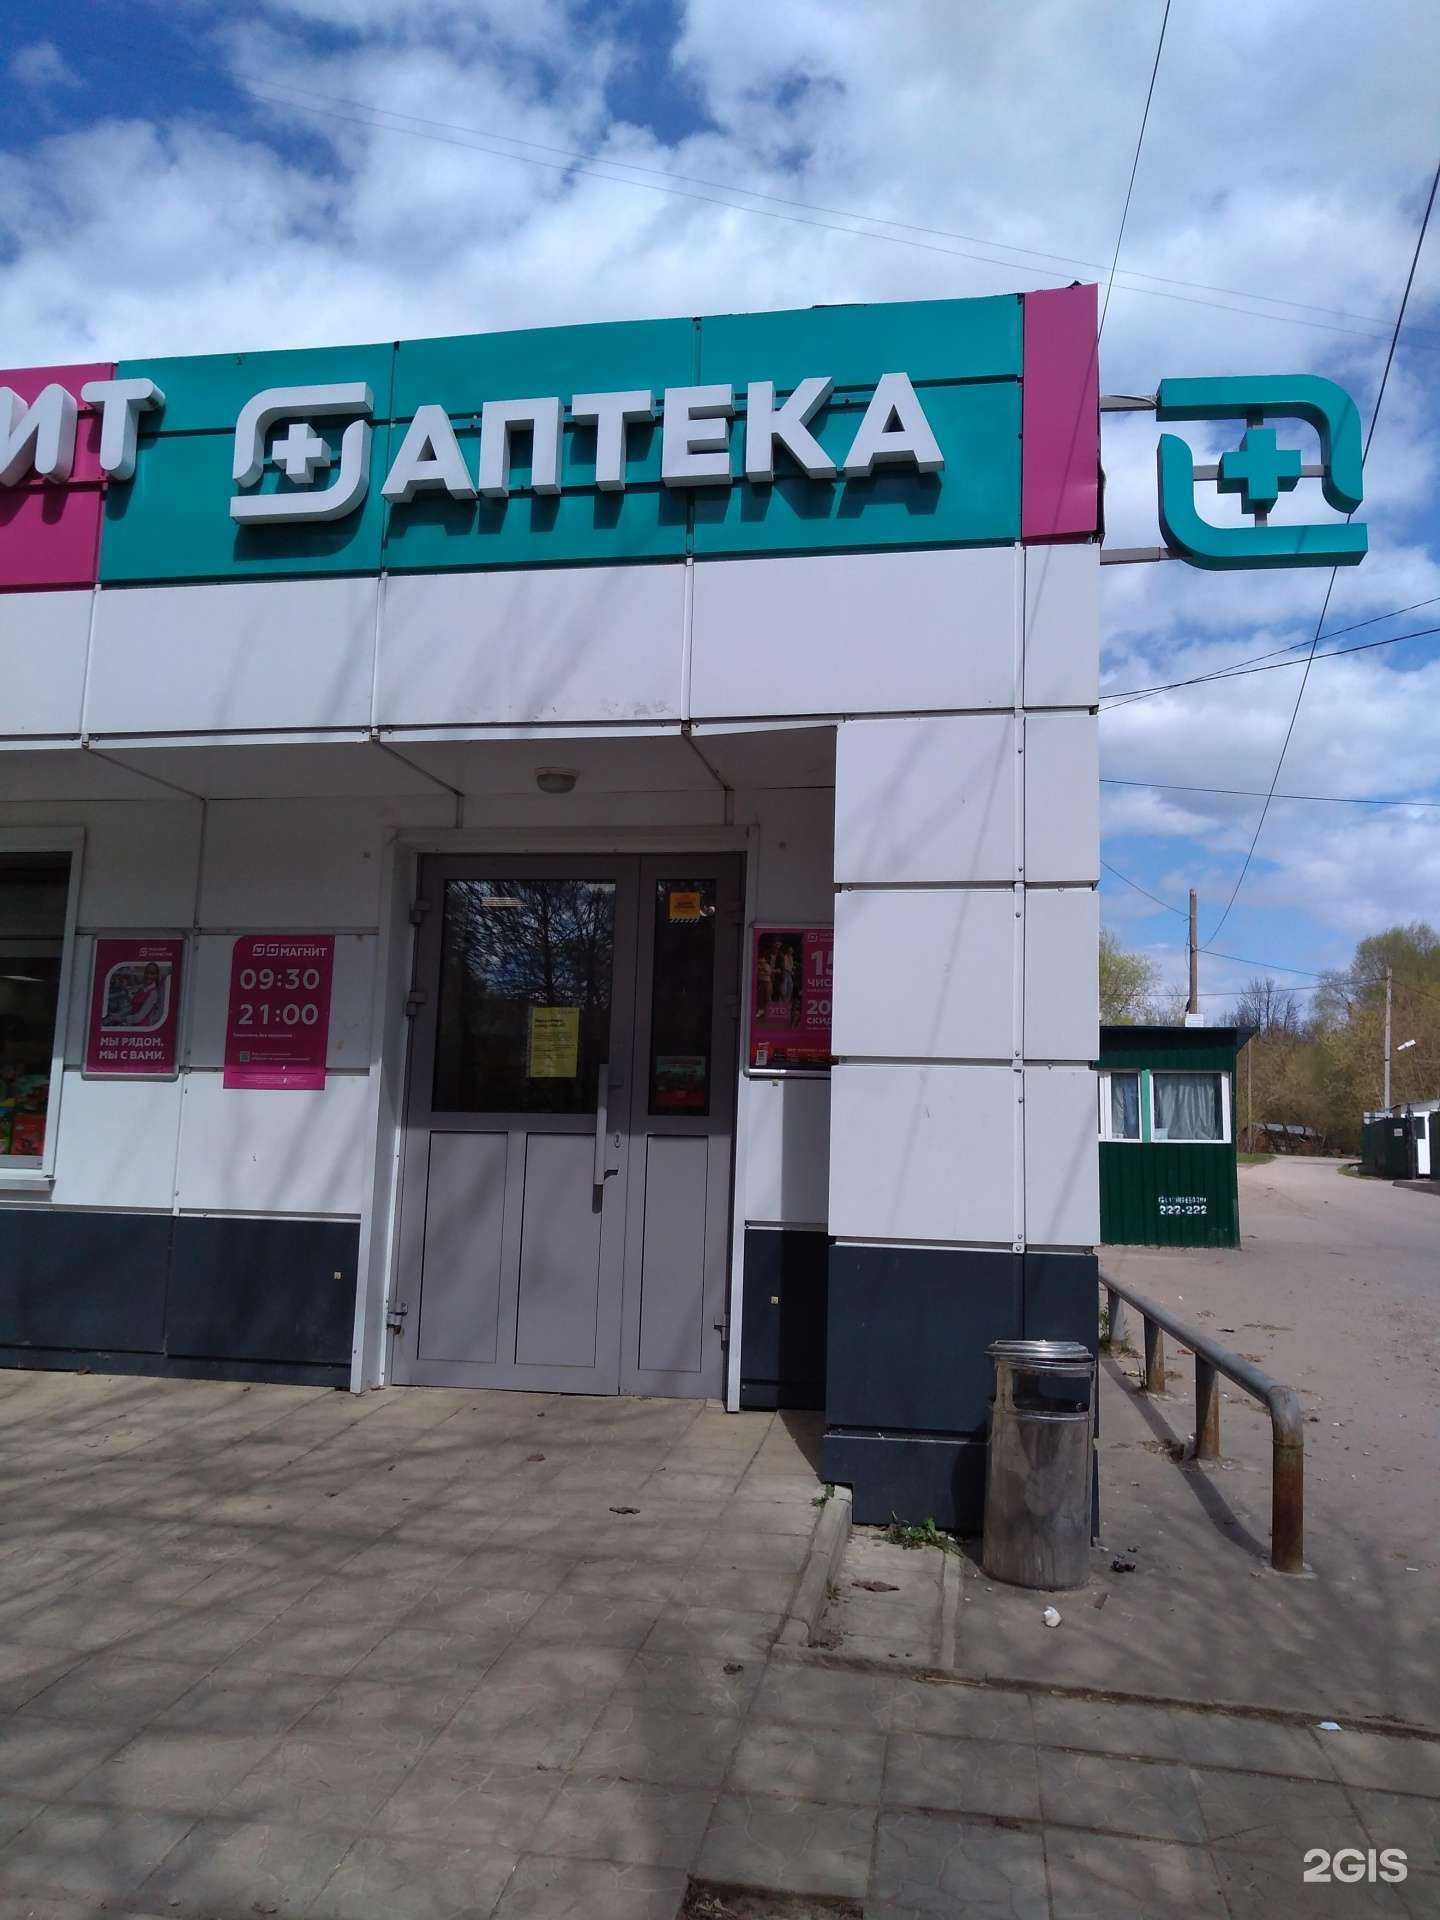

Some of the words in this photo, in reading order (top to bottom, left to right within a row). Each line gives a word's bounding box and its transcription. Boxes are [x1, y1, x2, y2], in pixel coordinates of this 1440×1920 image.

[381, 372, 945, 504] АПТЕКА
[280, 947, 328, 957] МАГНИТ
[240, 968, 320, 990] 09:30
[238, 1003, 319, 1025] 21:00
[100, 1036, 119, 1047] МЫ
[121, 1036, 164, 1048] РЯДОМ.
[99, 1050, 118, 1060] МЫ
[120, 1050, 128, 1060] С
[129, 1050, 165, 1060] ВАМИ.
